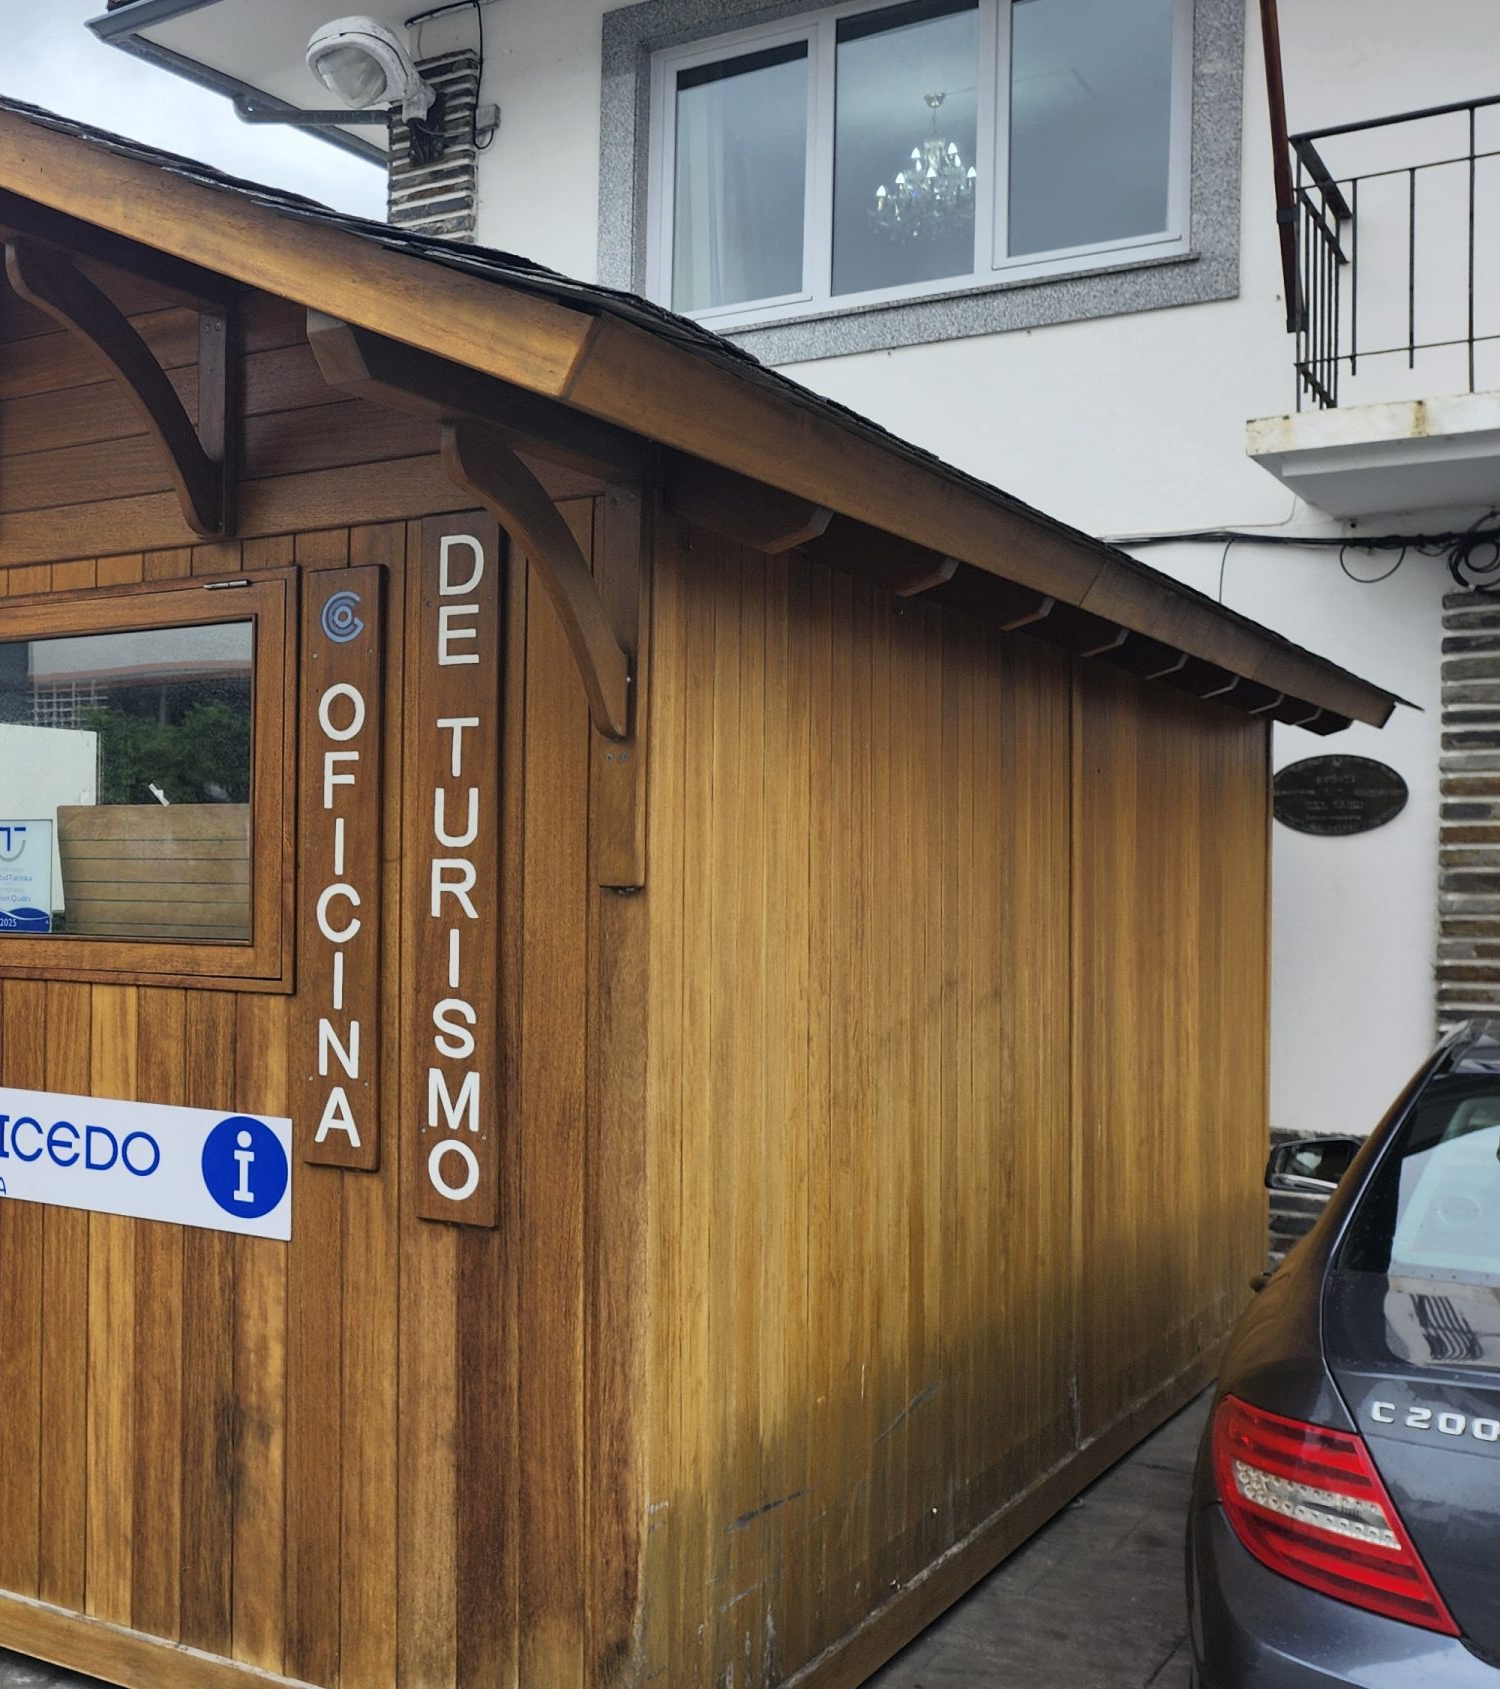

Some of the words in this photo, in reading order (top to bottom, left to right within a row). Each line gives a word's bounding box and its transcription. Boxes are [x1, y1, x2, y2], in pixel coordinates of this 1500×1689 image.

[438, 534, 485, 666] DE
[0, 918, 17, 927] 2025
[314, 683, 366, 1148] OFICINA
[427, 717, 481, 1200] TURISMO
[1371, 1400, 1395, 1423] C
[1405, 1406, 1500, 1442] 200
